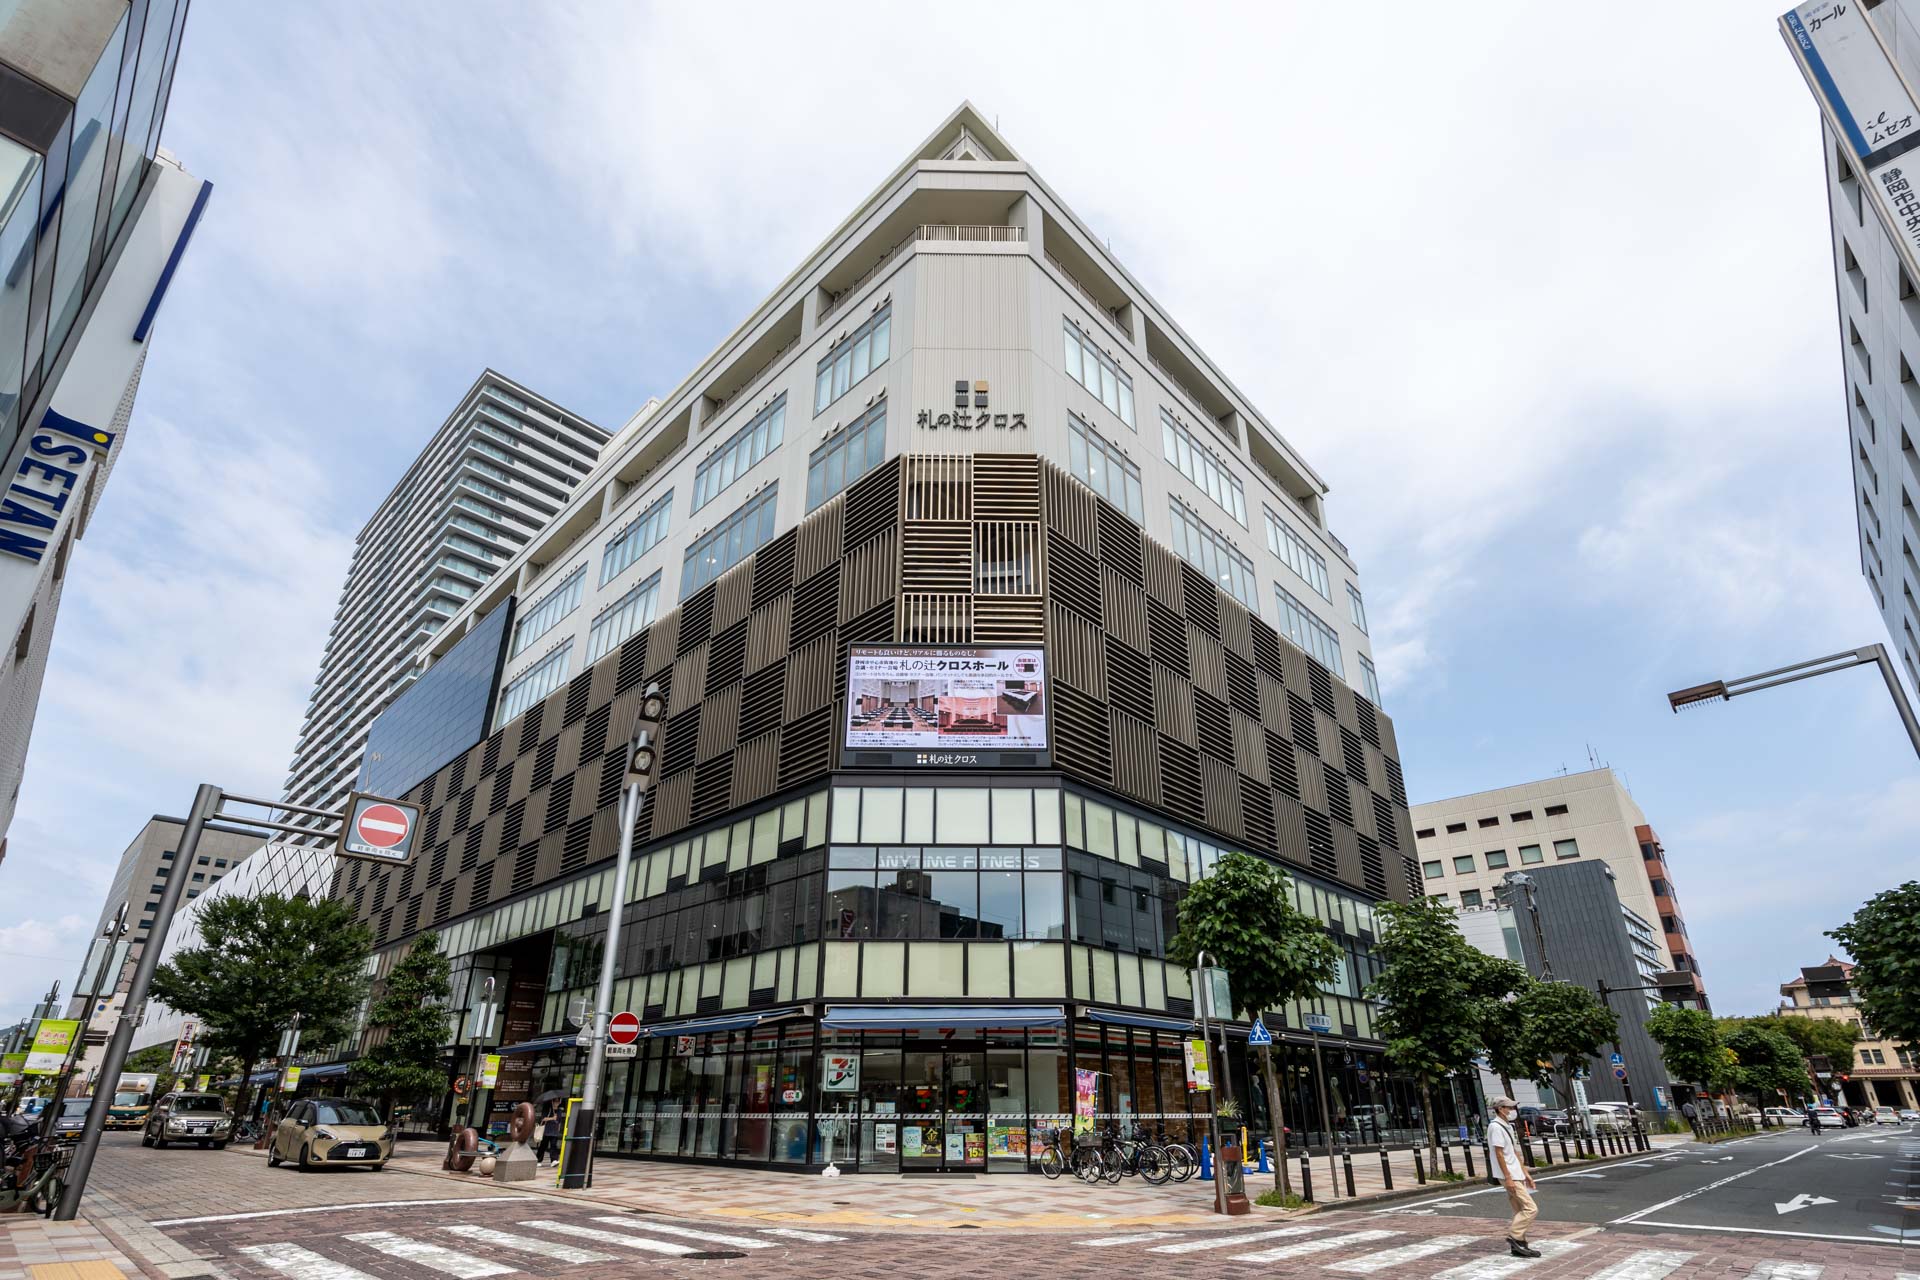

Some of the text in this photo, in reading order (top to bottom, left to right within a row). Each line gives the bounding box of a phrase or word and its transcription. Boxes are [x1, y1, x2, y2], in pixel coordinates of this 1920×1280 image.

[1809, 4, 1846, 33] カール
[1872, 115, 1912, 145] ムゼオ
[917, 409, 1028, 430] 札の辻クロス
[899, 659, 1009, 671] 札の辻クロスホール
[929, 754, 977, 764] 札の辻クロス
[873, 855, 1040, 869] ANYTIME FITNESS
